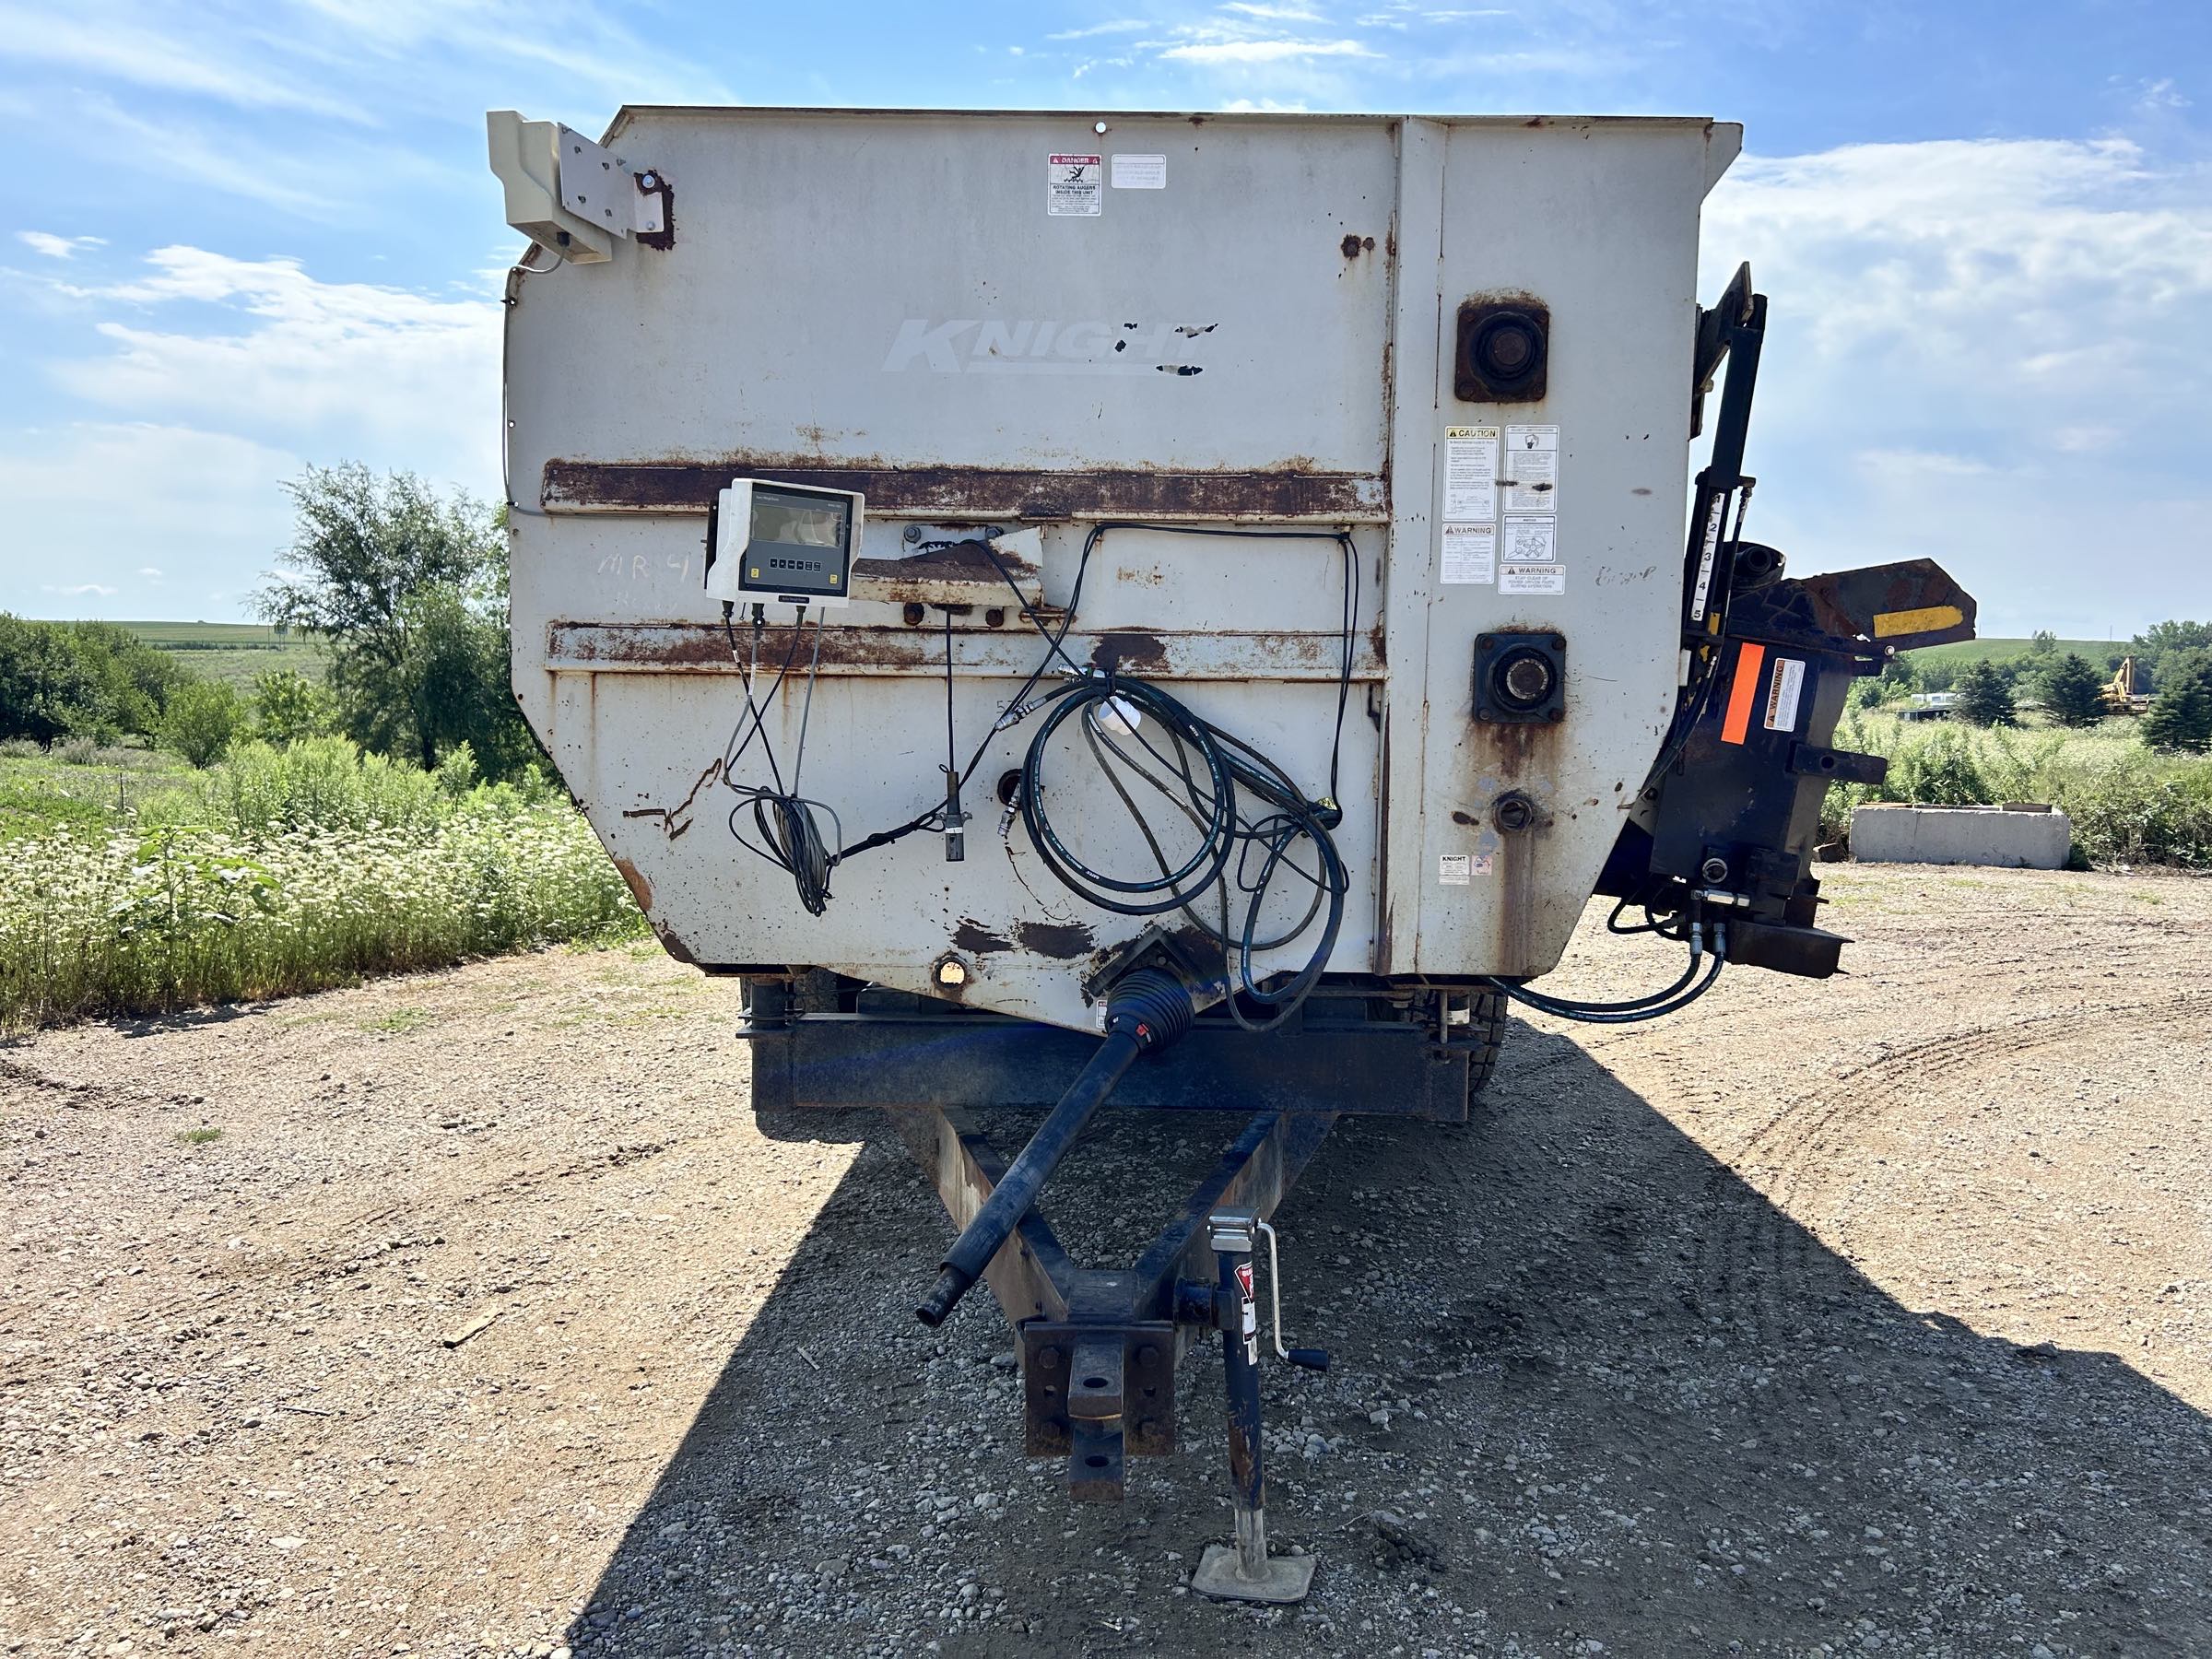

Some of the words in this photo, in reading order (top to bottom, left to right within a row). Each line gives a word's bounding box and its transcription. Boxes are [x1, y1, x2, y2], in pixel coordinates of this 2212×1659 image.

[1458, 429, 1496, 438] CAUTION
[1710, 524, 1717, 532] 2
[1704, 553, 1712, 561] 3
[1699, 582, 1706, 590] 4
[1694, 610, 1701, 618] 5
[1770, 665, 1783, 710] WARNING
